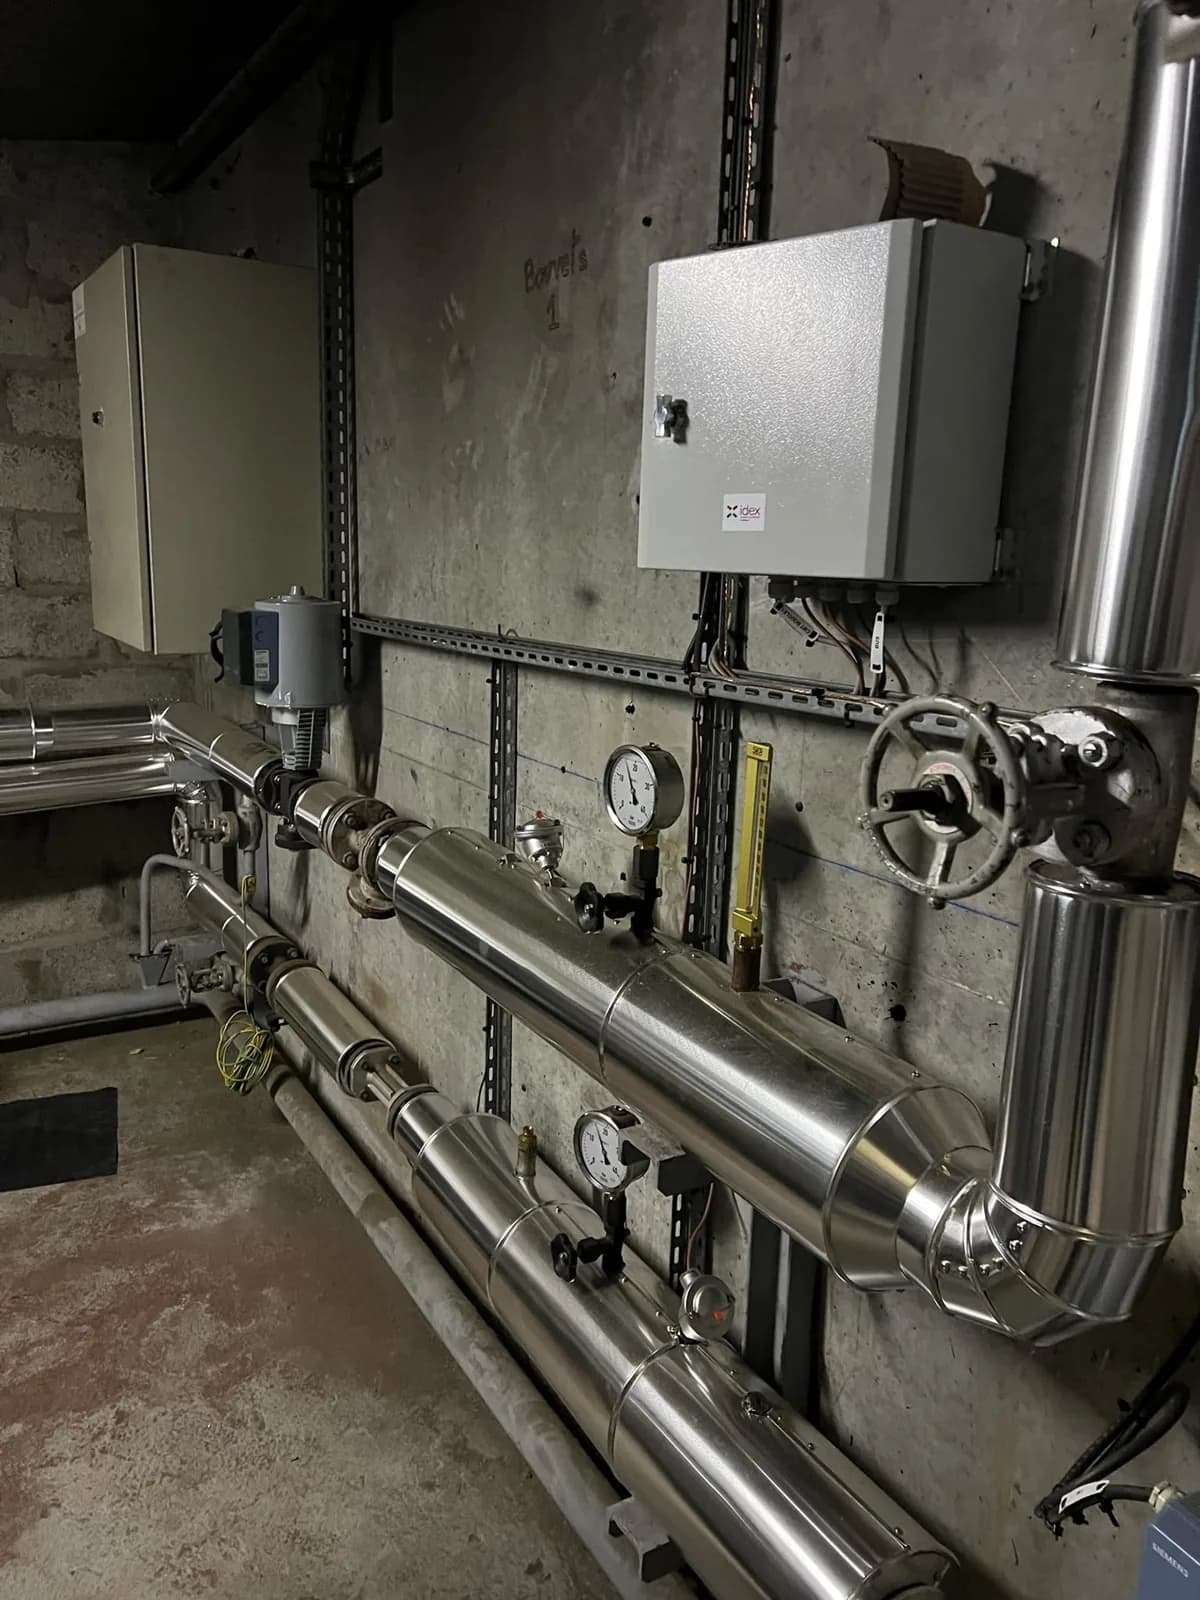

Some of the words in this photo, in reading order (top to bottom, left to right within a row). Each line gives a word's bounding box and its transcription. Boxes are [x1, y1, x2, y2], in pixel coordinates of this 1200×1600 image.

[546, 293, 560, 331] 1
[740, 504, 760, 516] idex
[1152, 1542, 1189, 1578] SIEMENS
